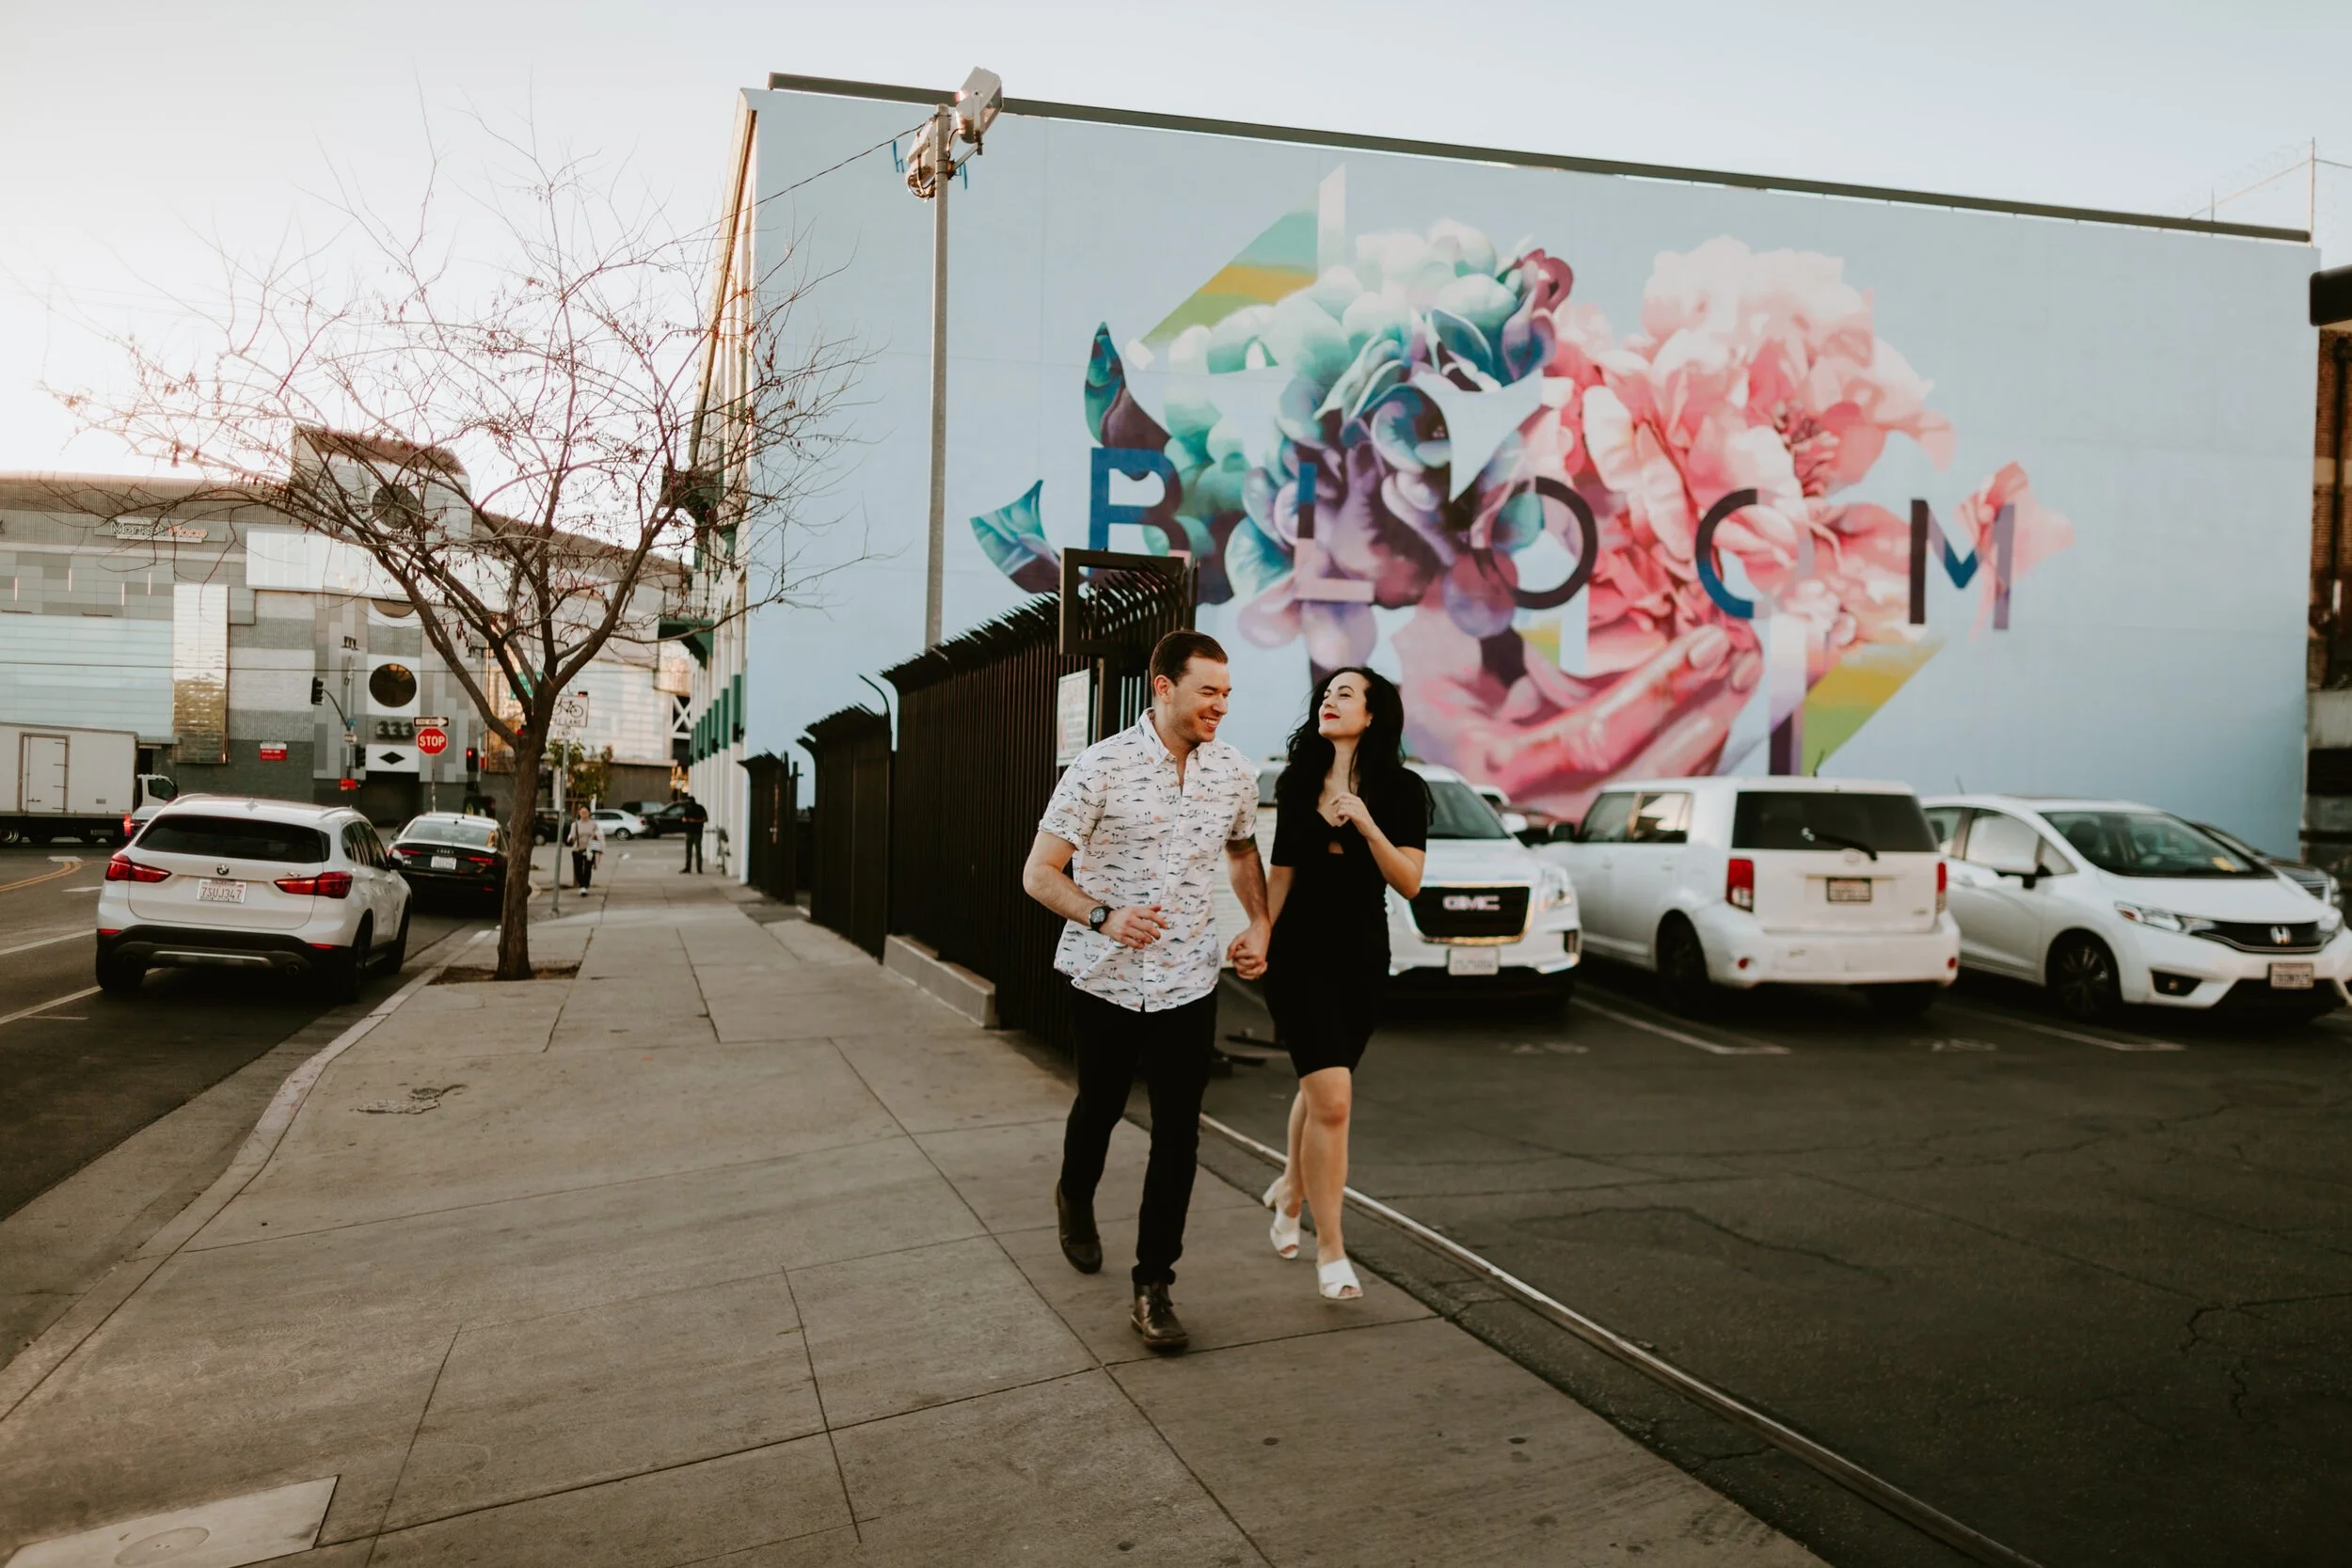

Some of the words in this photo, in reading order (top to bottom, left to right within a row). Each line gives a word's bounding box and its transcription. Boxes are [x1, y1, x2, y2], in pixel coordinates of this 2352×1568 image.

[376, 721, 416, 741] 333
[419, 735, 445, 748] STOP
[202, 887, 242, 899] 7SUJ347
[1442, 895, 1501, 911] GMC
